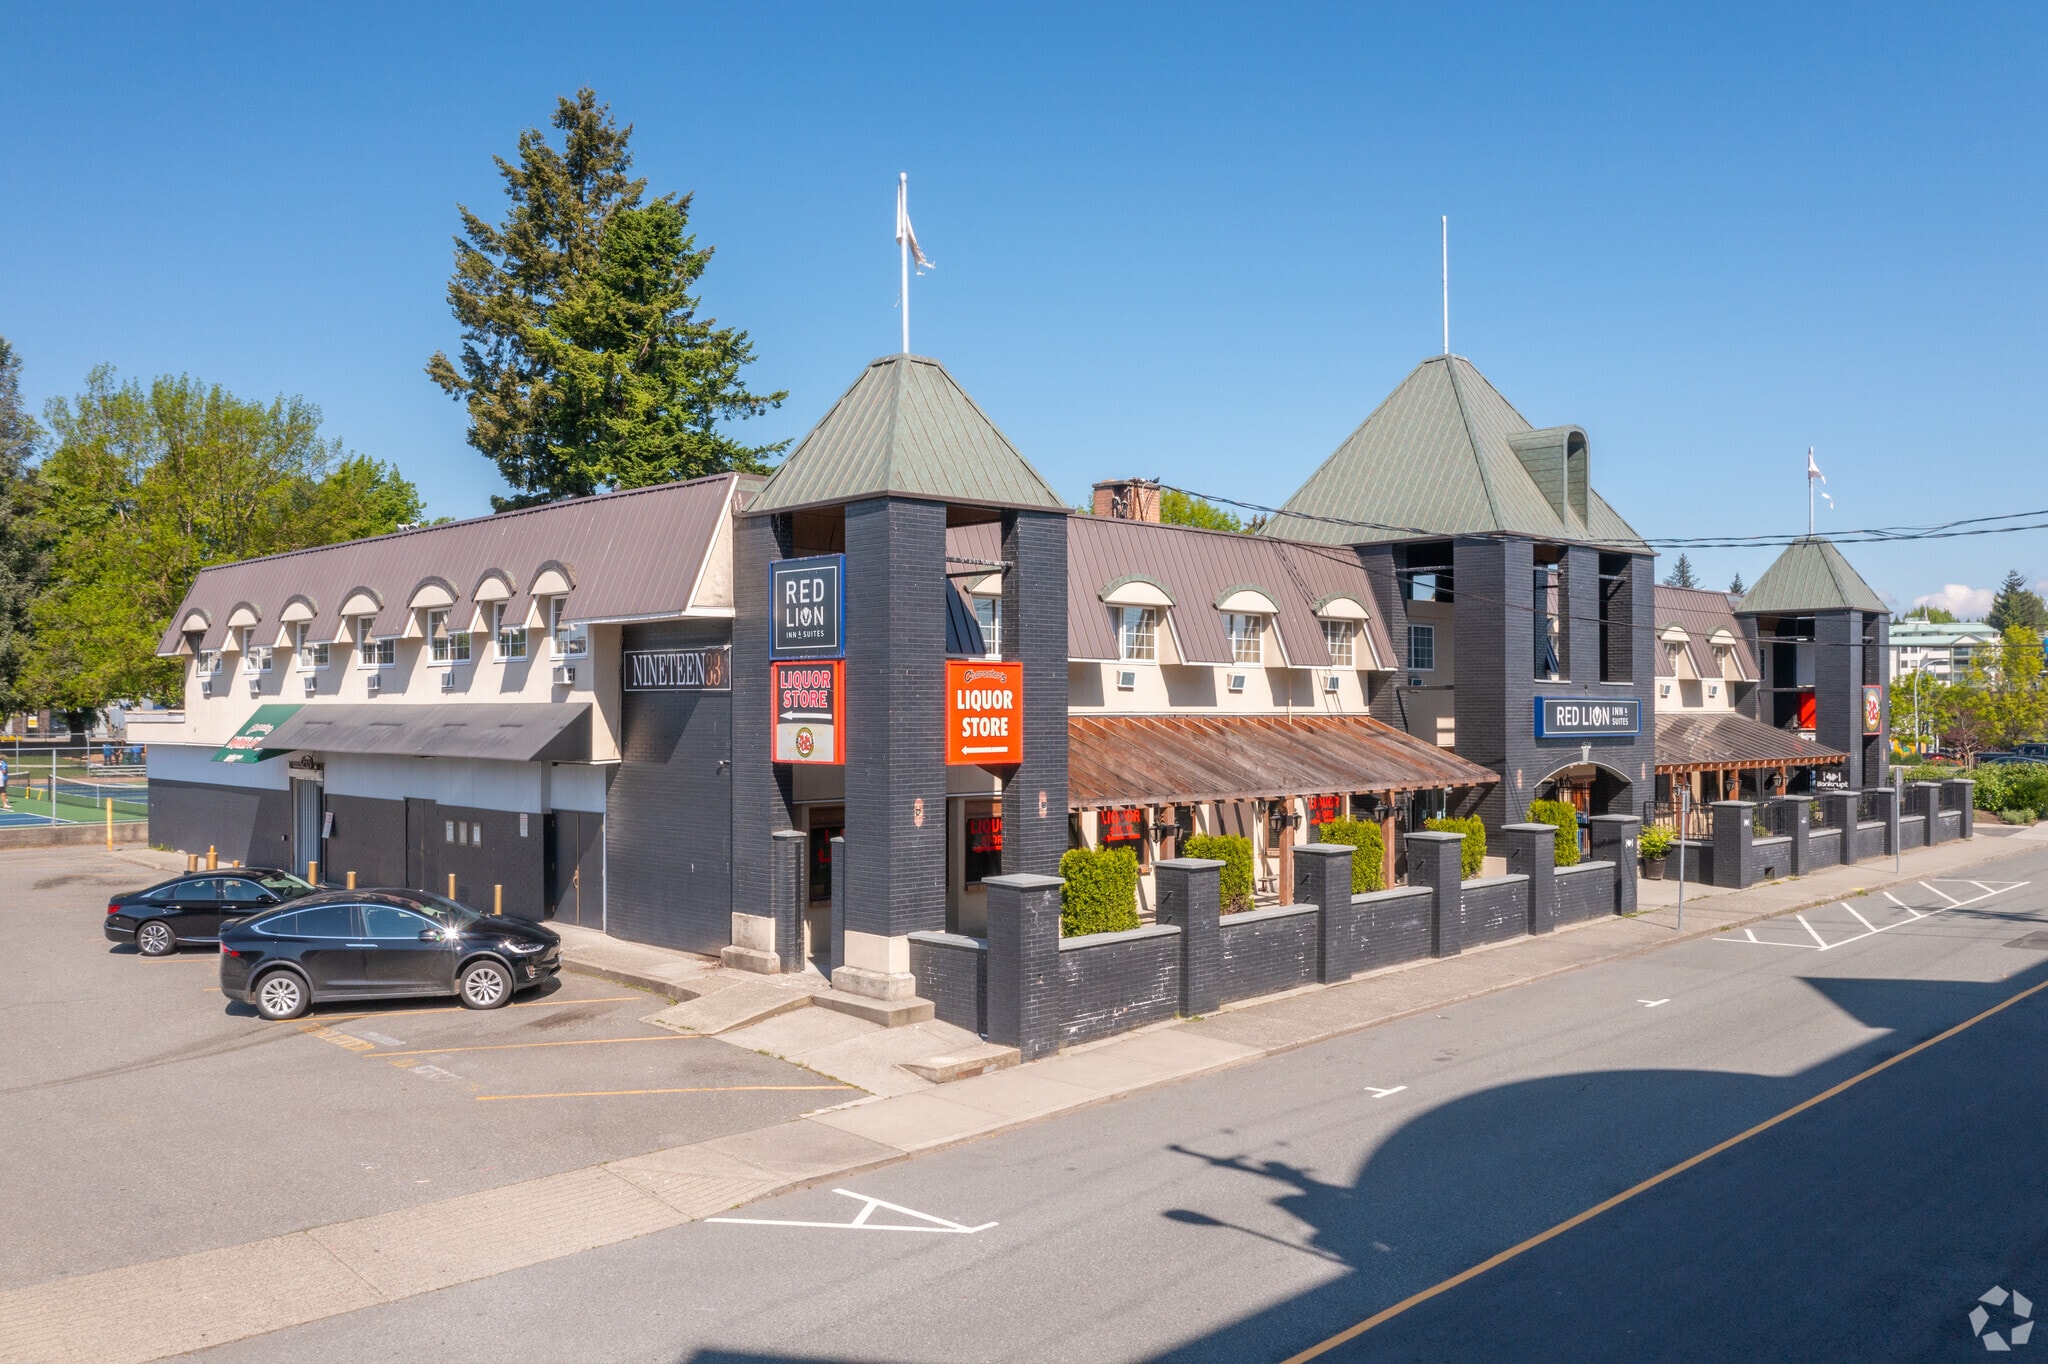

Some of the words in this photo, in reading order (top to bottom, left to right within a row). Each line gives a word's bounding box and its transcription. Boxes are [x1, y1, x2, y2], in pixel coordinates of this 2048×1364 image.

[786, 578, 824, 605] RED
[786, 605, 824, 627] LION
[786, 631, 797, 639] INN
[803, 630, 825, 638] SUITES
[780, 670, 831, 691] LIQUOR
[783, 690, 828, 708] STORE
[957, 689, 1013, 712] LIQUOR
[1556, 706, 1580, 726] RED
[1582, 705, 1610, 727] LION
[1611, 706, 1624, 716] INN
[1611, 717, 1629, 726] SUITES
[962, 716, 1009, 738] STORE
[970, 818, 1003, 835] LIQU
